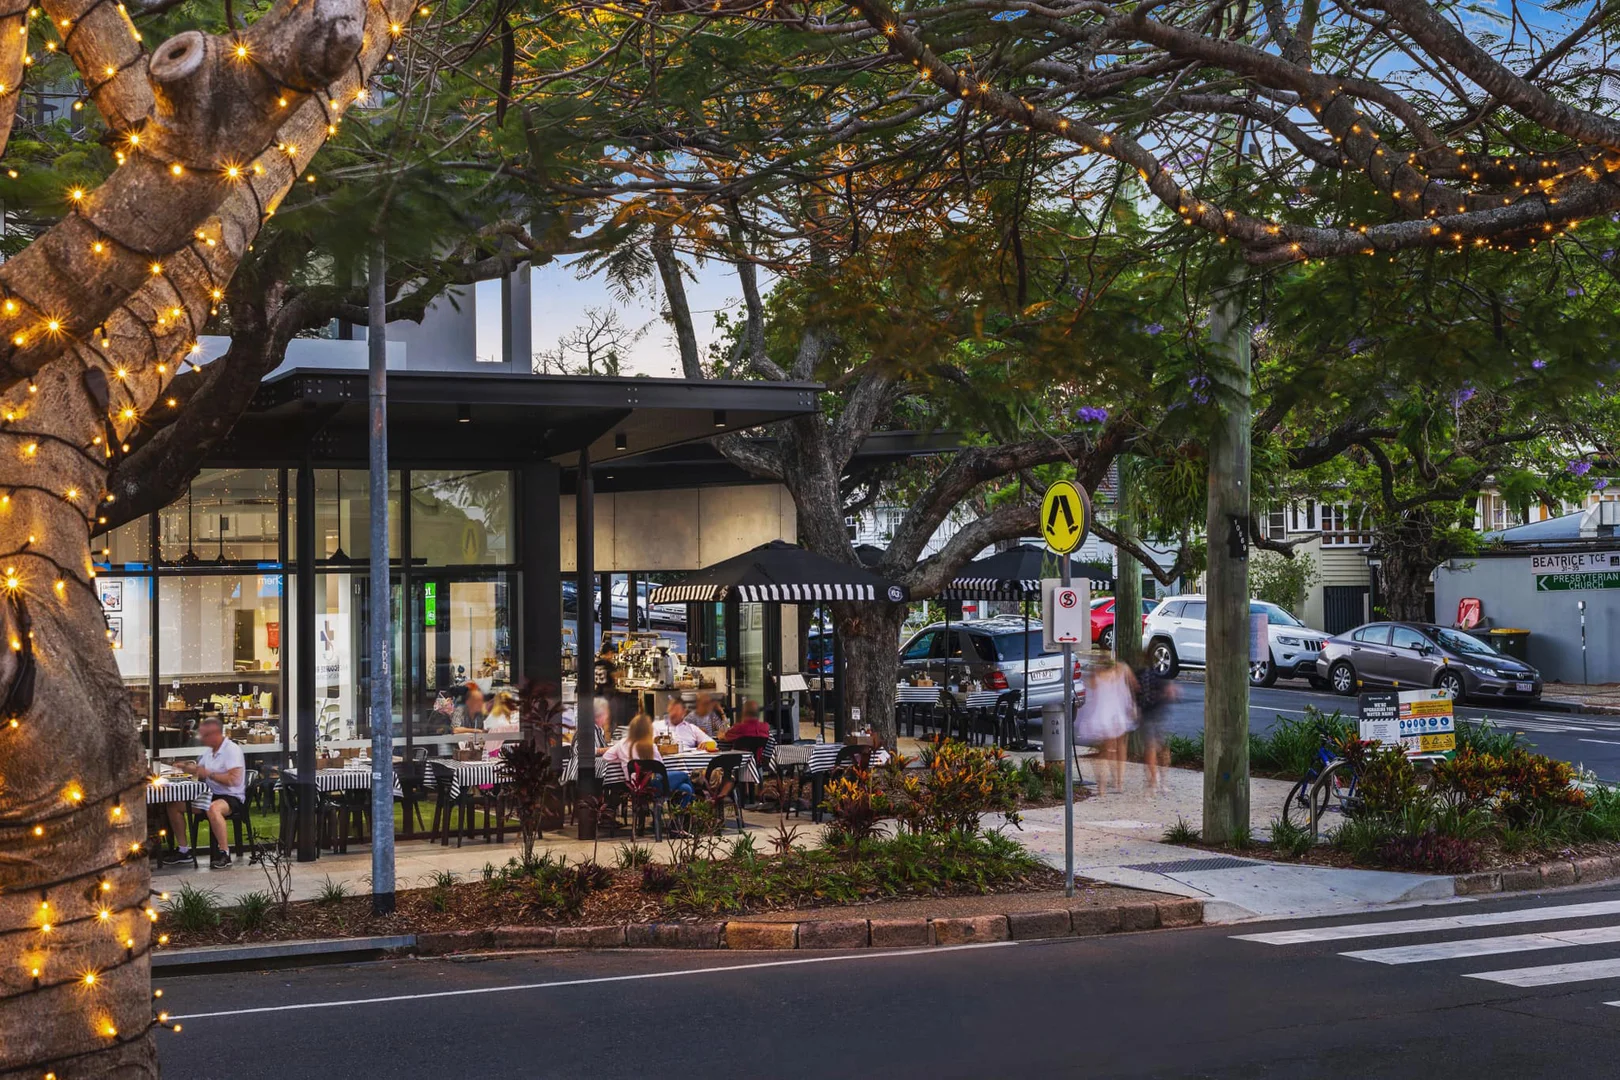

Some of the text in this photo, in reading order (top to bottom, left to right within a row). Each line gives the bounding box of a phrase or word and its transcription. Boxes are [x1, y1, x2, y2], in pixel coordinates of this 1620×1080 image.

[1532, 555, 1585, 567] BEATRICE
[1553, 572, 1619, 583] PRESBYTERIAN
[1568, 580, 1604, 590] CHURCH
